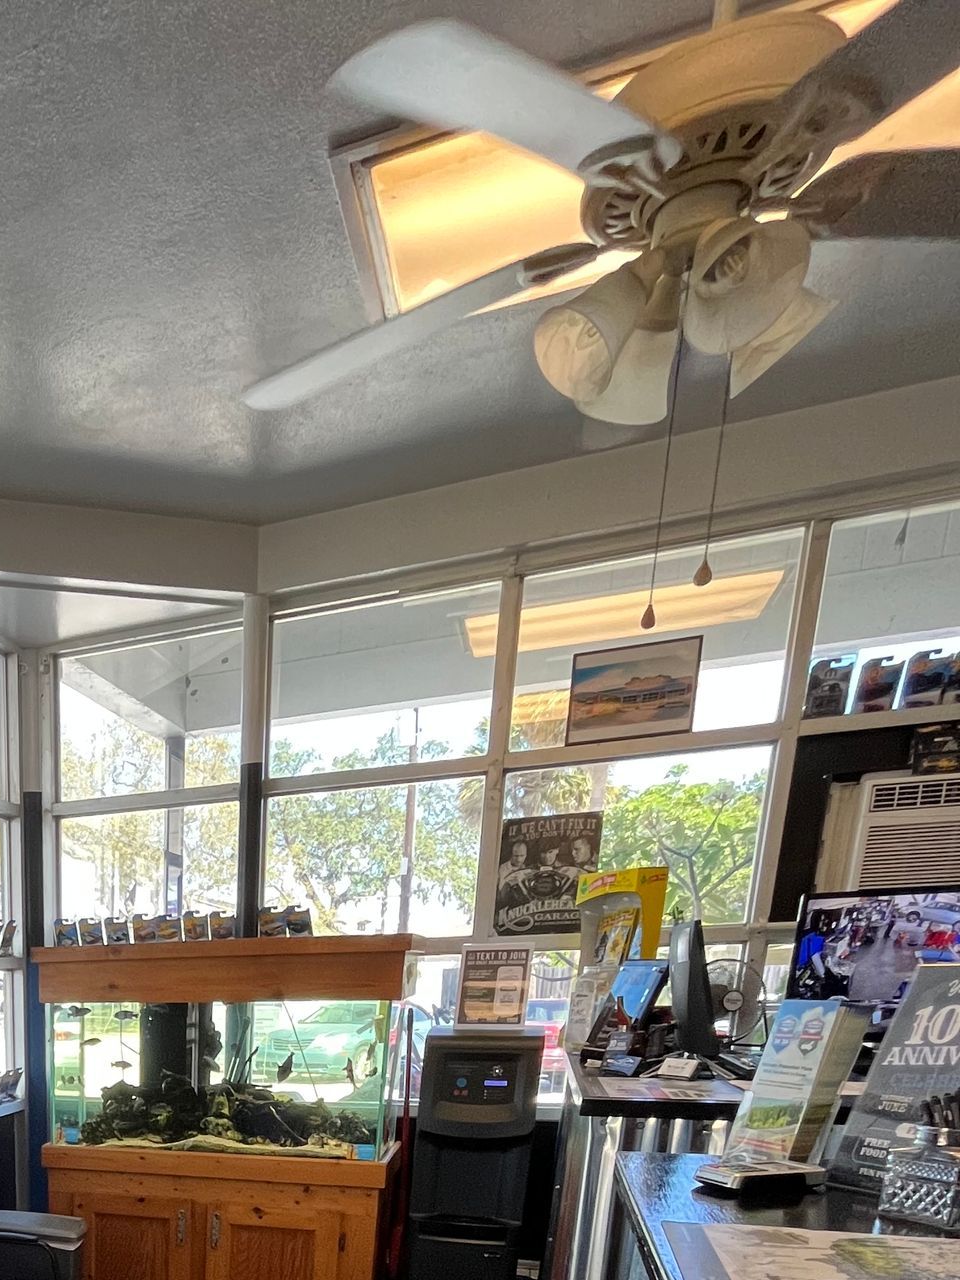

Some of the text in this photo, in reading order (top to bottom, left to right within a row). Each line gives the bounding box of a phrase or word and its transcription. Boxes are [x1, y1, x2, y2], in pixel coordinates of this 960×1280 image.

[521, 821, 536, 834] WE
[568, 817, 585, 830] FIX
[586, 818, 597, 830] IT
[525, 831, 541, 841] YOU
[497, 898, 579, 926] KNUCKLEHEA
[535, 911, 580, 921] GARAG
[476, 951, 527, 960] TEXT TO JOIN
[864, 1137, 892, 1149] FREE
[860, 1147, 887, 1159] FOOD
